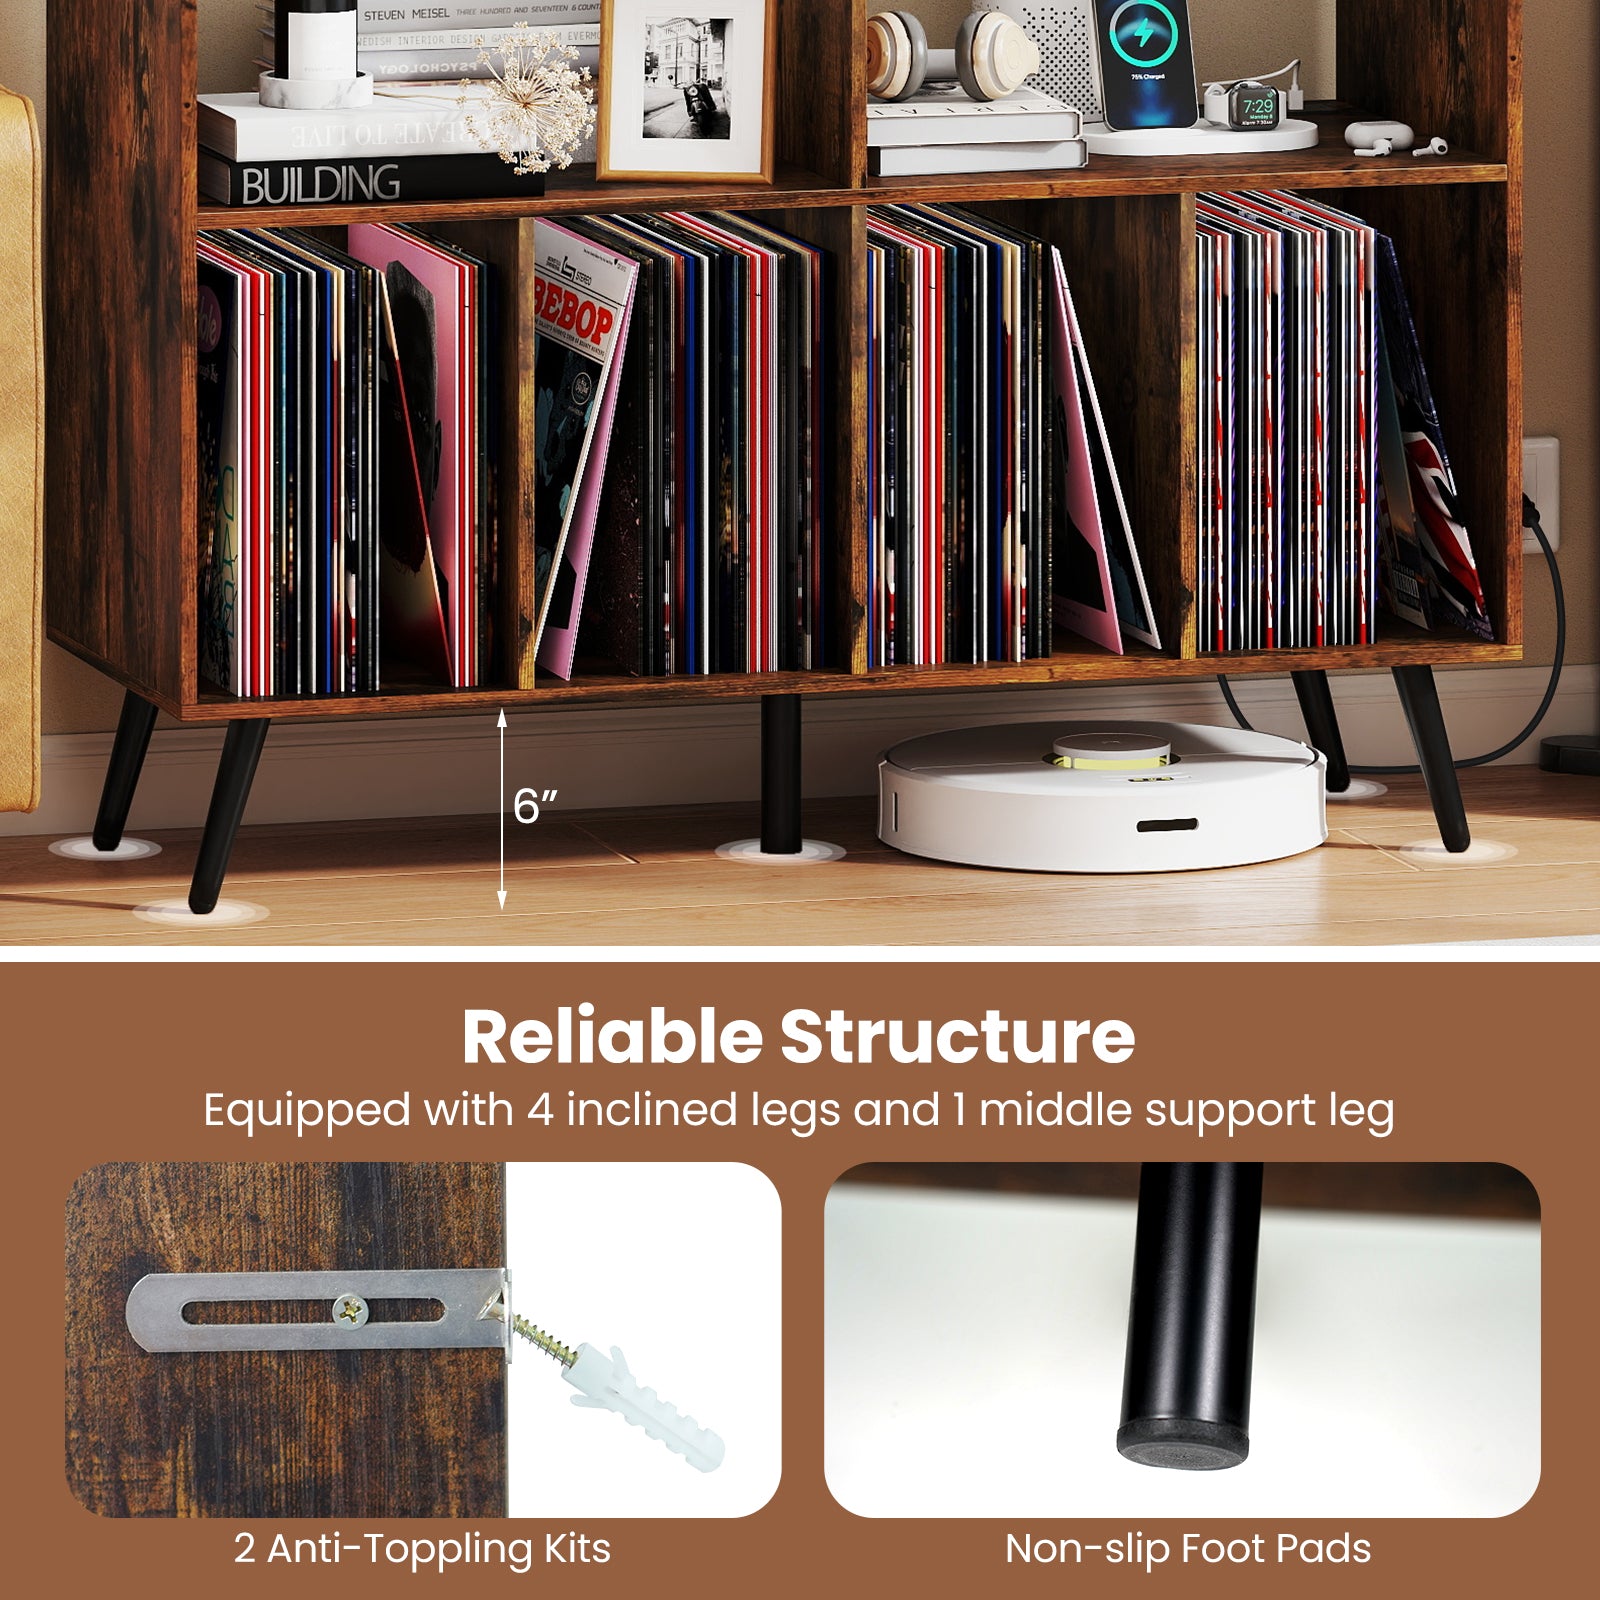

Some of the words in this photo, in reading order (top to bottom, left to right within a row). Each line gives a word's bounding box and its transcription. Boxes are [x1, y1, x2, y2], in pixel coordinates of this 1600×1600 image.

[364, 10, 405, 21] STEVEN
[412, 8, 450, 19] MEISEL
[456, 8, 477, 16] THREE
[480, 7, 511, 15] HUNDRED
[531, 4, 568, 13] SEVENTEEN
[578, 3, 601, 11] COUNT
[399, 34, 445, 45] INTERIOR
[1243, 99, 1274, 113] 7:29
[292, 124, 347, 148] LIVE
[355, 123, 387, 146] TO
[396, 118, 488, 145] REATE
[242, 163, 401, 205] BUILDING
[534, 276, 613, 346] BEBOP
